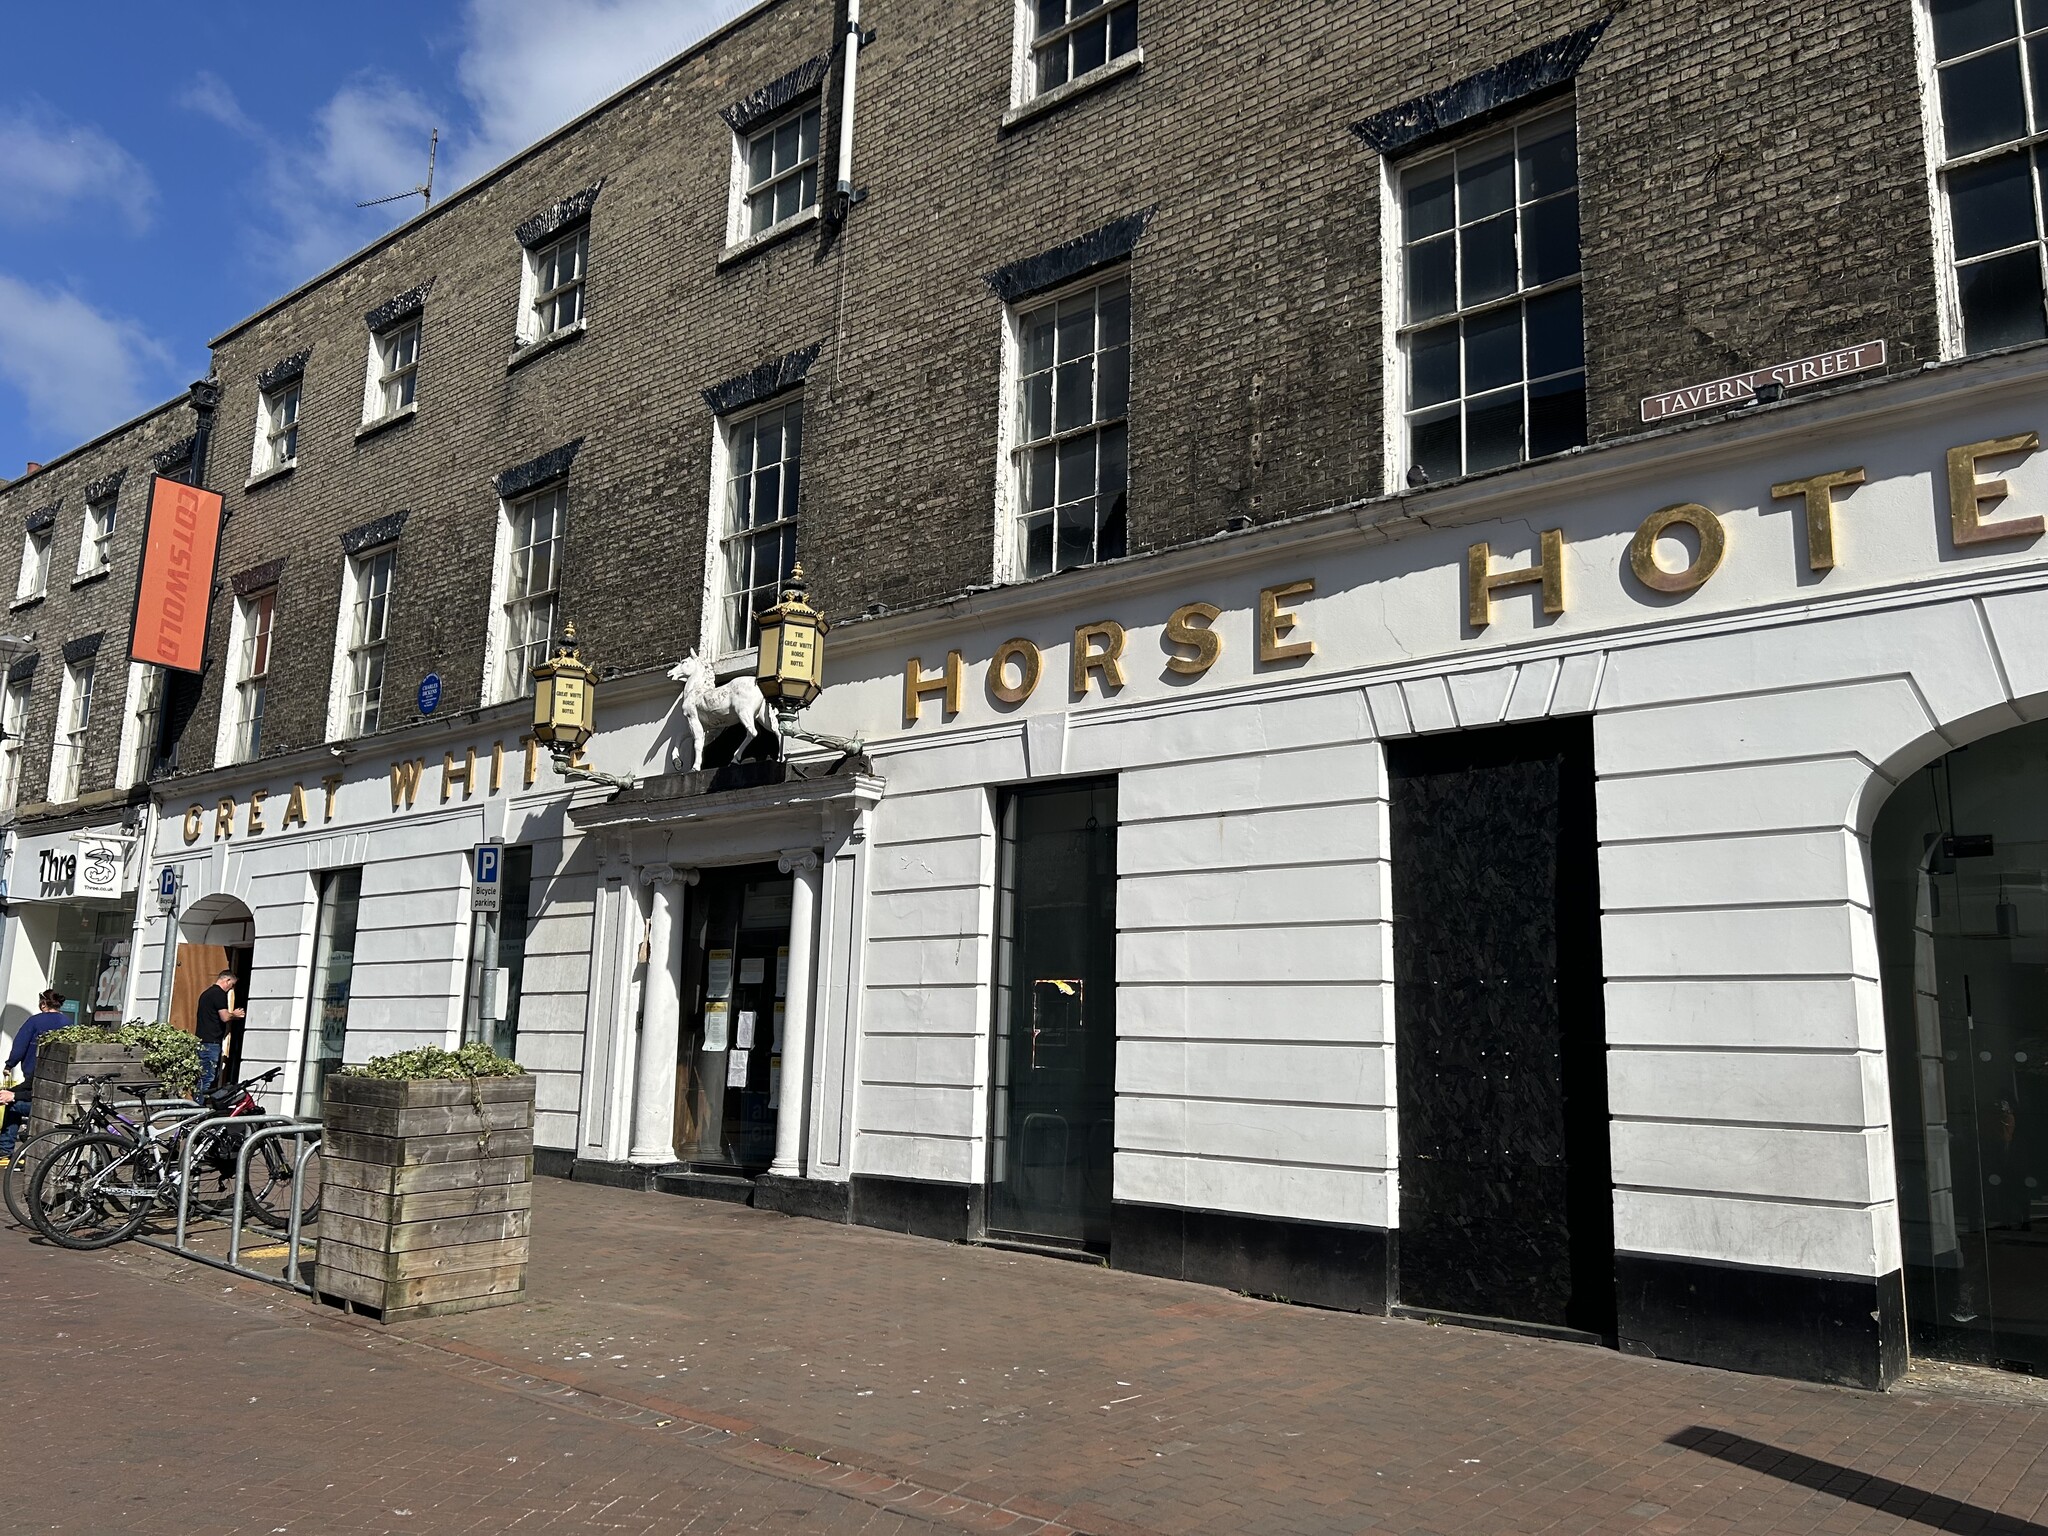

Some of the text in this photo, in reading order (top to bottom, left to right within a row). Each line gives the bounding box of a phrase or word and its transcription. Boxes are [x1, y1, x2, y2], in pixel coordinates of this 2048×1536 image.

[1654, 346, 1867, 416] TAVERN STREET
[156, 486, 200, 663] COTSWOLD
[183, 775, 344, 845] GREAT
[905, 580, 1316, 720] HORSE
[1467, 429, 2047, 626] HOTE
[39, 848, 77, 883] Thre
[481, 851, 495, 880] P
[83, 884, 114, 892] Three.co.uk
[164, 871, 174, 893] P
[476, 886, 497, 897] Bicycle
[474, 898, 497, 909] parking
